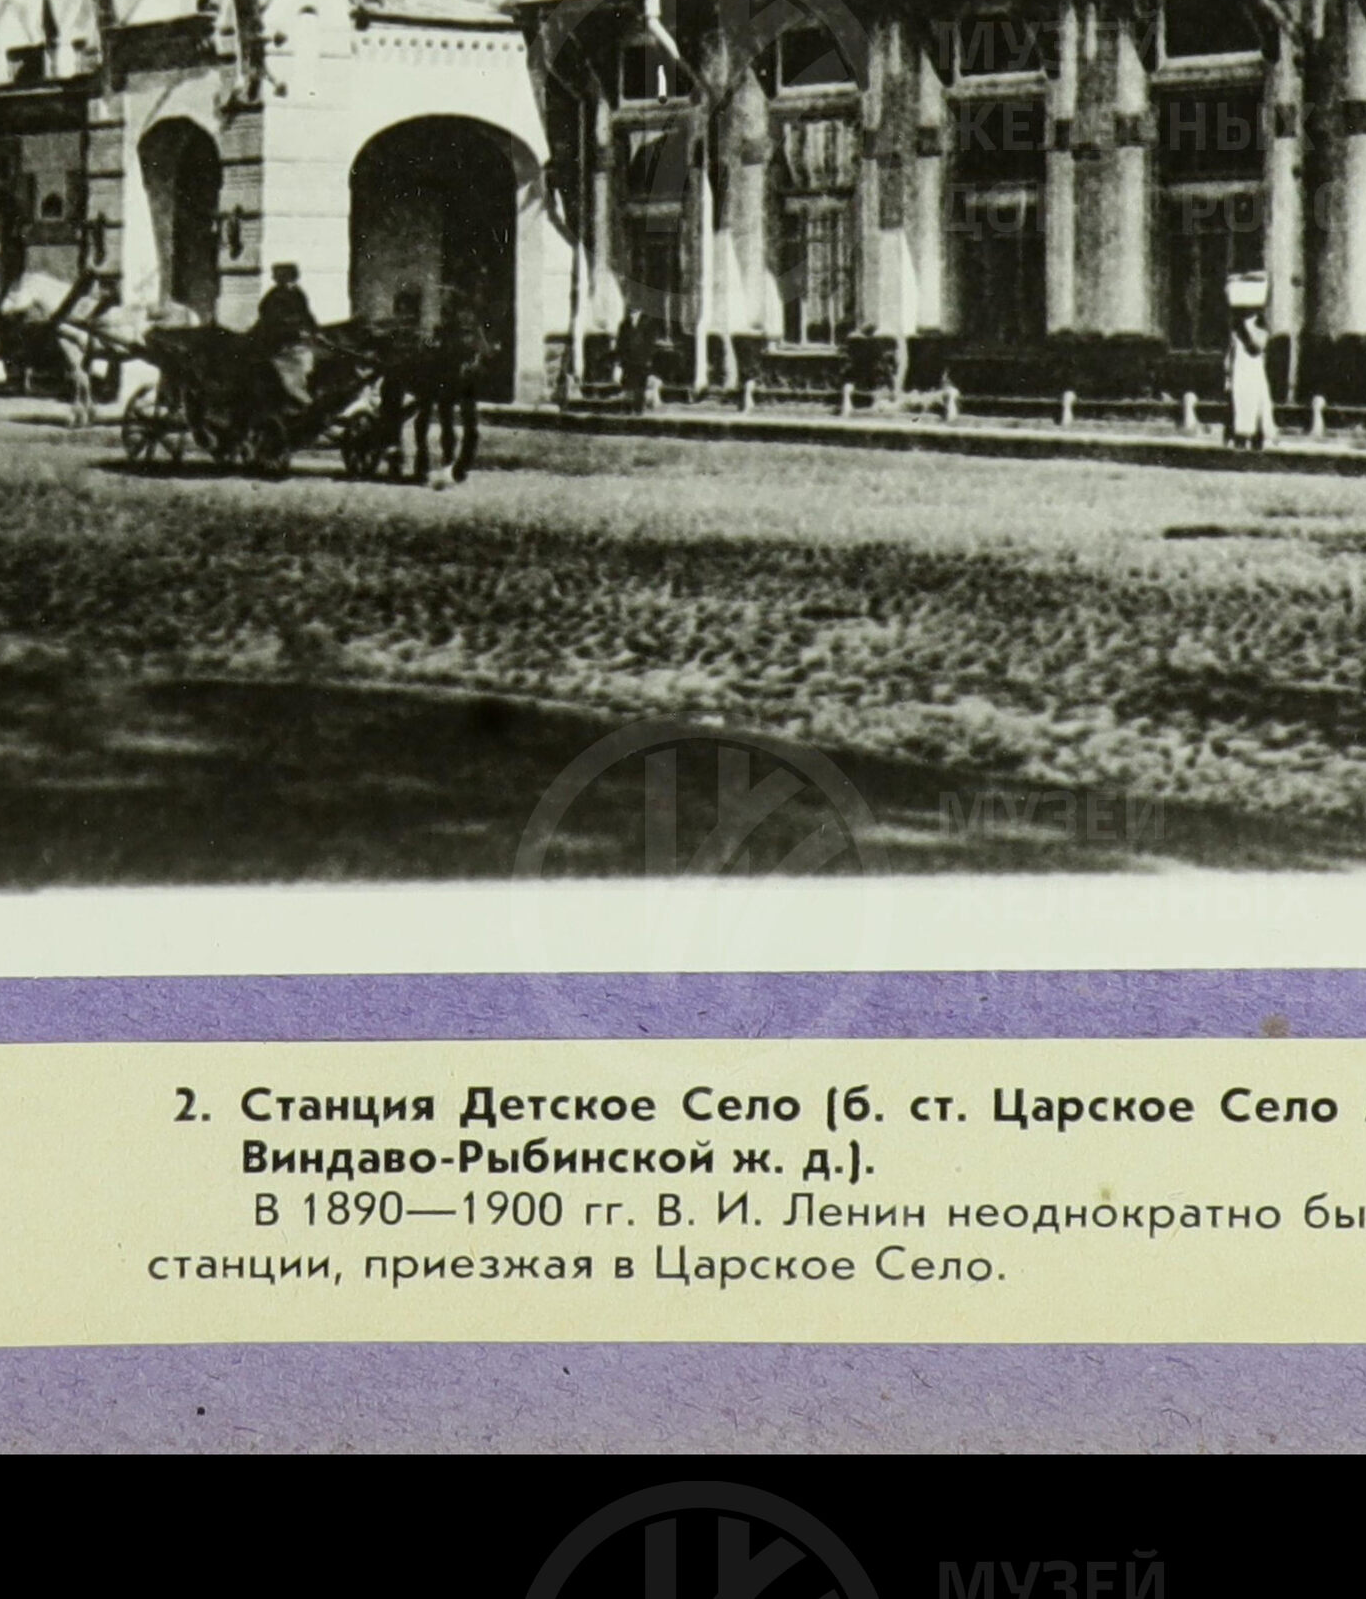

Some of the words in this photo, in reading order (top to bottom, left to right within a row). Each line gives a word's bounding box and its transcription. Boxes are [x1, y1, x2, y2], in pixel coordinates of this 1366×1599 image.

[174, 1087, 211, 1122] 2.
[240, 1086, 435, 1129] Станция
[459, 1086, 656, 1129] Детское
[682, 1086, 801, 1122] Село
[910, 1096, 966, 1122] ст.
[993, 1087, 1194, 1133] Царское
[1220, 1087, 1338, 1123] Село
[242, 1136, 714, 1182] Виндаво-Рыбинской
[732, 1149, 784, 1174] ж.
[255, 1192, 279, 1226] В
[585, 1202, 634, 1226] гг.
[658, 1193, 694, 1227] В.
[717, 1191, 761, 1226] И.
[782, 1192, 925, 1227] Ленин
[948, 1204, 1281, 1239] неоднократно
[147, 1256, 342, 1286] станции,
[365, 1255, 593, 1289] приезжая
[614, 1256, 634, 1279] в
[656, 1245, 855, 1290] Царское
[875, 1245, 1005, 1282] Село.
